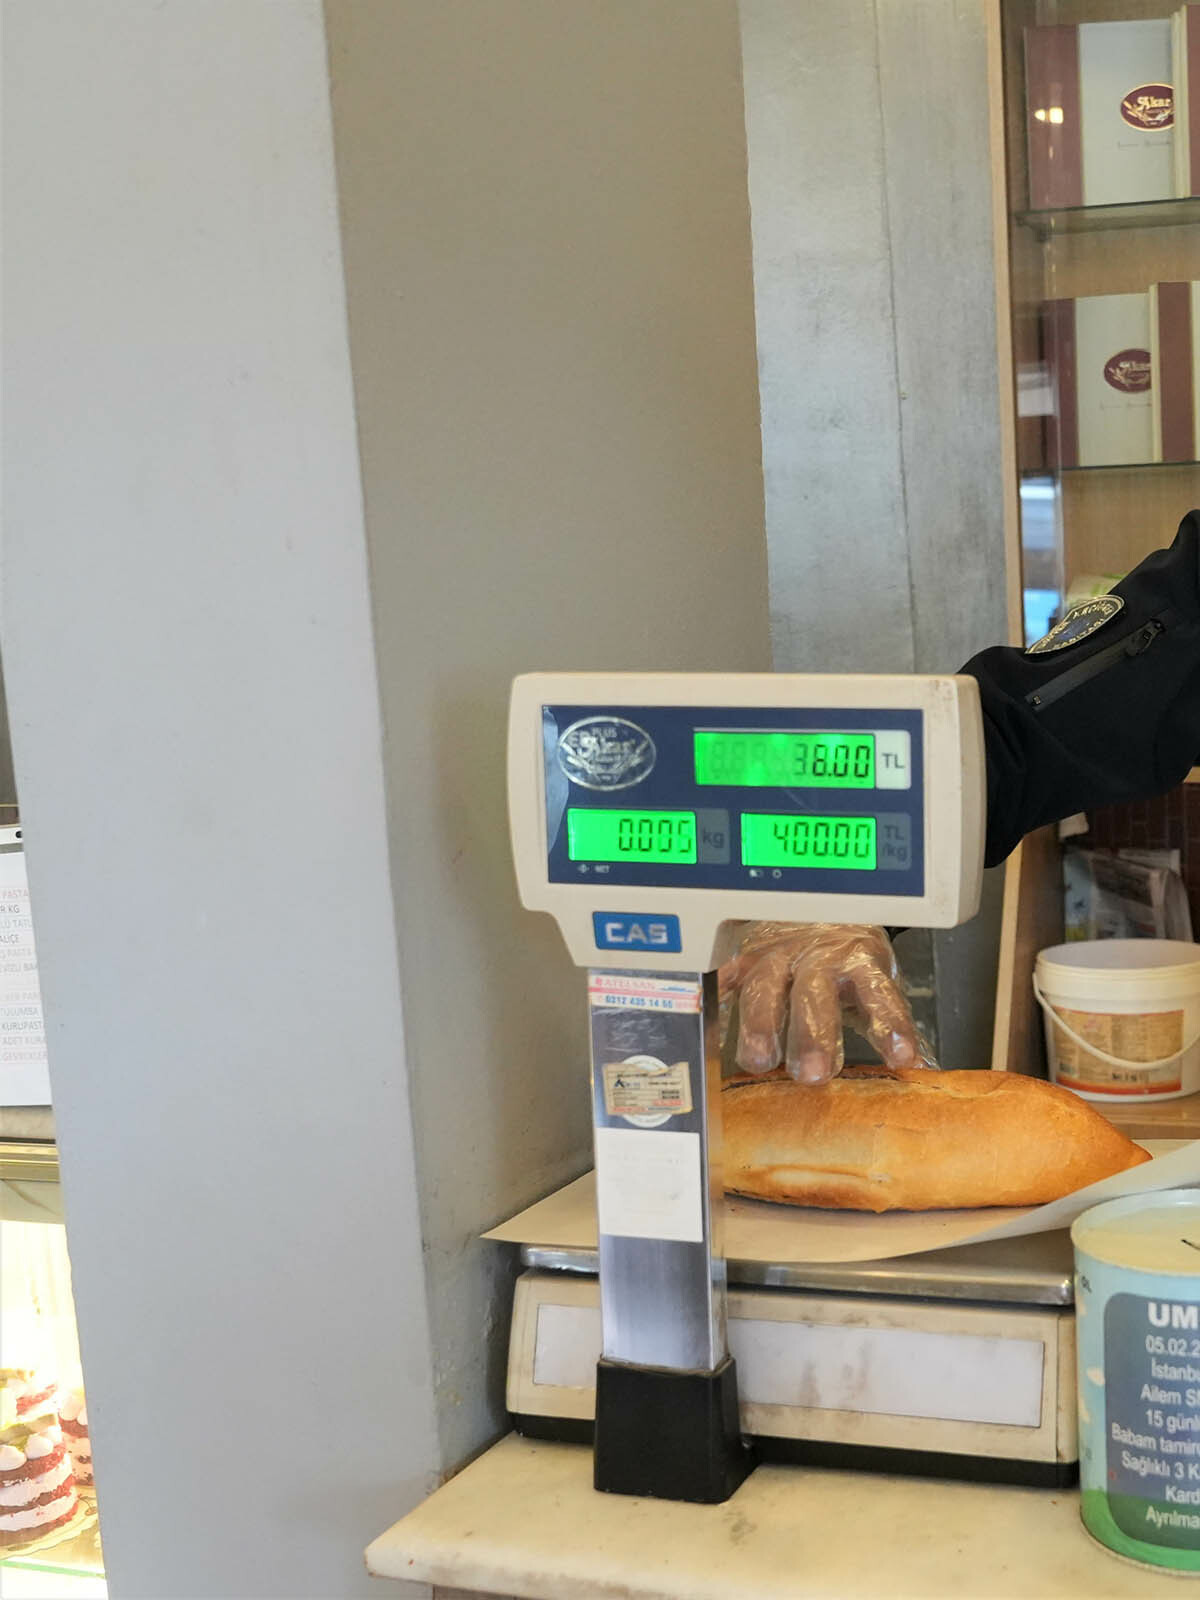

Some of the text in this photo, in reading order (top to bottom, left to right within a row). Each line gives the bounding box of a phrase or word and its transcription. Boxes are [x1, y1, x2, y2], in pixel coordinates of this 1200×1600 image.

[882, 753, 905, 769] TL
[703, 830, 724, 848] kg
[884, 825, 904, 840] TL
[605, 922, 668, 944] CAS
[1140, 1384, 1182, 1405] Ailem
[1146, 1409, 1164, 1427] 15
[1111, 1422, 1157, 1449] Babam
[1174, 1462, 1185, 1480] 3
